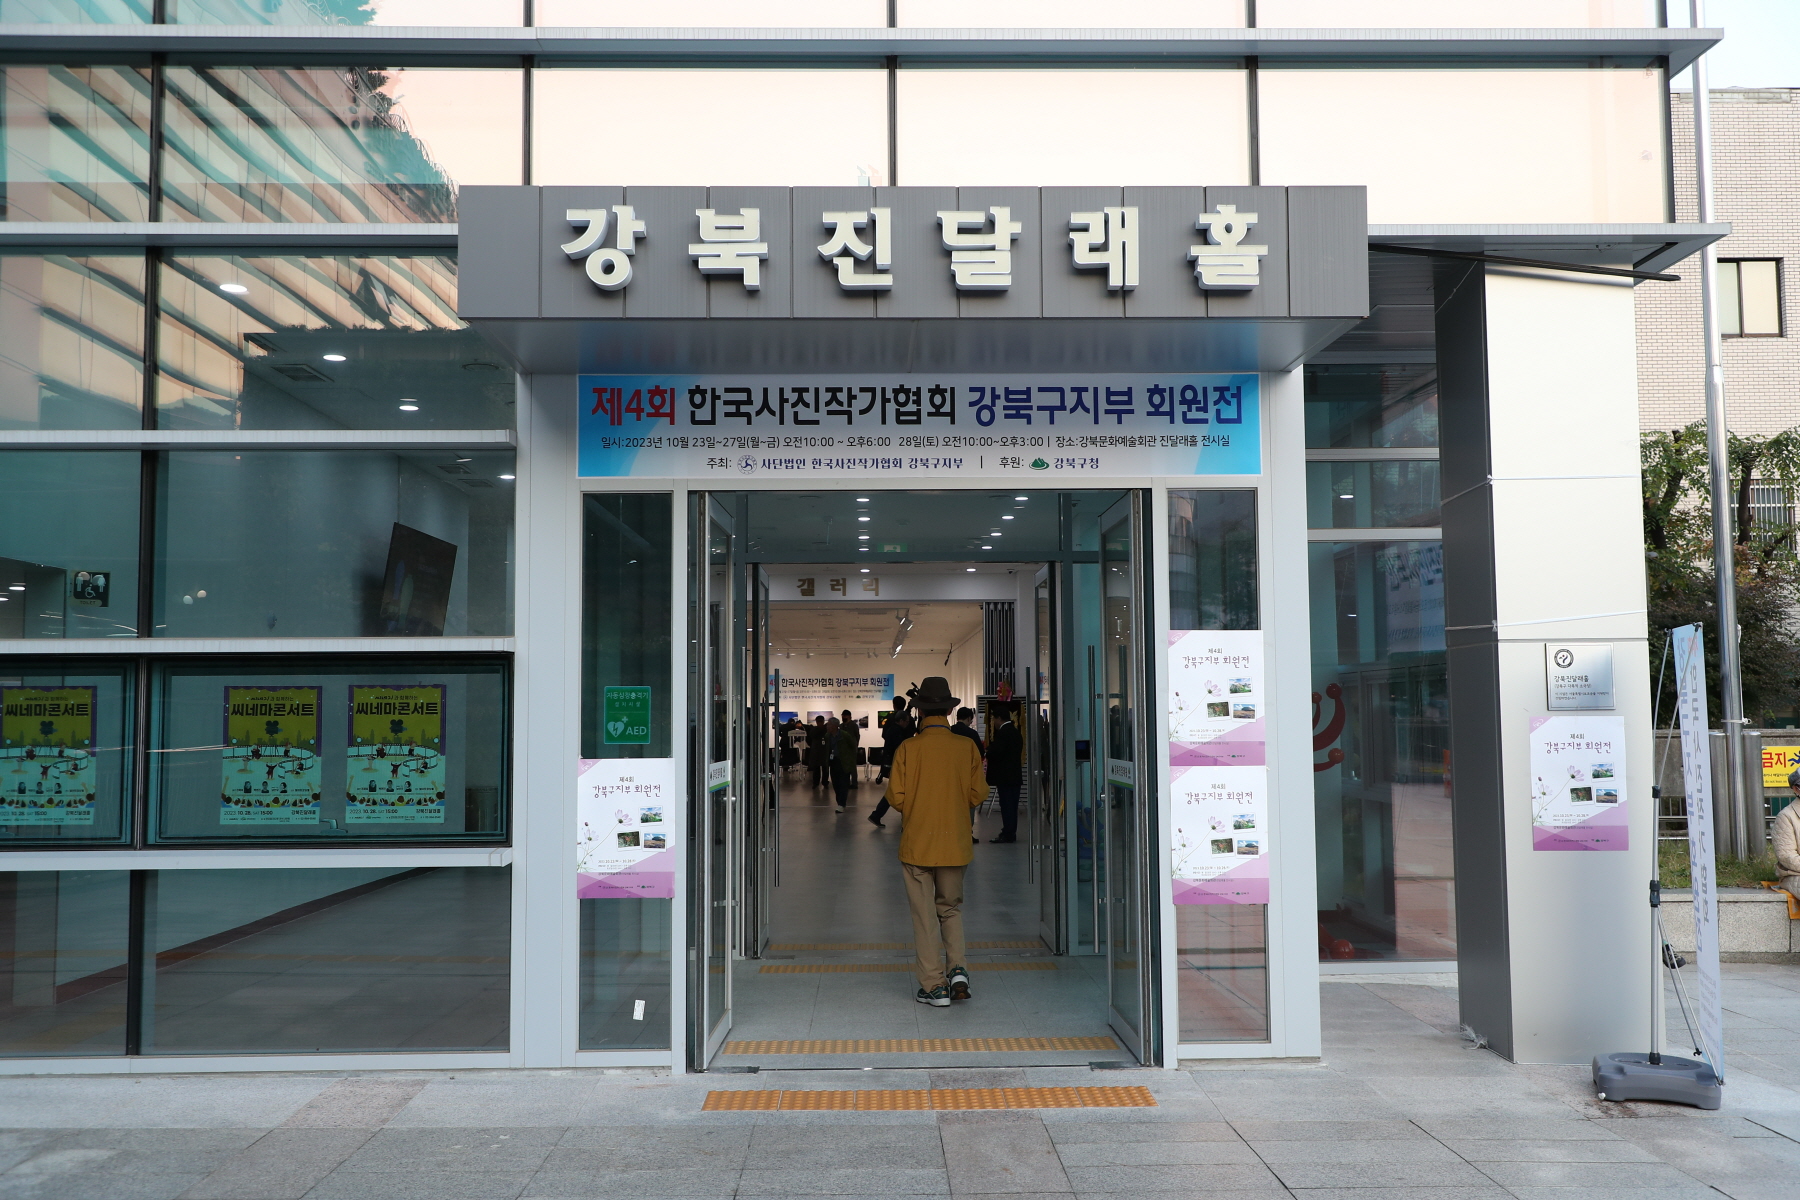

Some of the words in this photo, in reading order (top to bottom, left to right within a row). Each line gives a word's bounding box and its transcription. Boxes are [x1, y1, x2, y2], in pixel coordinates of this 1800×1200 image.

[561, 204, 1268, 291] 강북진달래홀
[592, 385, 675, 426] 제4회
[687, 384, 956, 426] 한국사진작가협회
[968, 386, 1135, 427] 강북구지부
[1146, 384, 1243, 425] 회원전
[601, 436, 663, 449] 일시:2023년
[667, 436, 690, 449] 10월
[692, 436, 781, 449] 23일~27일(월~금)
[783, 436, 835, 449] 오전10:00
[846, 436, 891, 448] 오후6:00
[898, 436, 940, 449] 28일(토)
[941, 436, 1044, 448] 오전10:00~오후3:00
[1055, 436, 1158, 448] 장소:강북문화예술회관
[1159, 435, 1199, 448] 진달래홀
[1200, 434, 1231, 447] 전시실
[706, 457, 732, 470] 주최:
[761, 458, 806, 470] 사단법인
[811, 458, 903, 470] 한국사진작가협회
[907, 458, 964, 470] 강북구지부
[999, 456, 1025, 469] 후원:
[1053, 457, 1100, 470] 강북구청
[796, 577, 880, 597] 갤러리
[1182, 656, 1220, 669] 강북구지부
[1223, 655, 1250, 669] 회원전
[781, 678, 834, 687] 한국사진작가협회
[836, 677, 869, 687] 강북구지부
[870, 677, 890, 687] 회원전
[1554, 675, 1589, 683] 강북진달래홀
[606, 692, 649, 700] 자동심장충격기
[5, 704, 89, 717] 씨네마콘서트
[231, 703, 314, 716] 씨네마콘서트
[355, 702, 438, 715] 씨네마콘서트
[626, 726, 648, 735] AED
[1544, 741, 1582, 754] 강북구지부
[1585, 741, 1611, 753] 회원전
[592, 785, 631, 798] 강북구지부
[634, 784, 660, 797] 회원전
[1185, 792, 1223, 805] 강북구지부
[1226, 791, 1253, 804] 회원전
